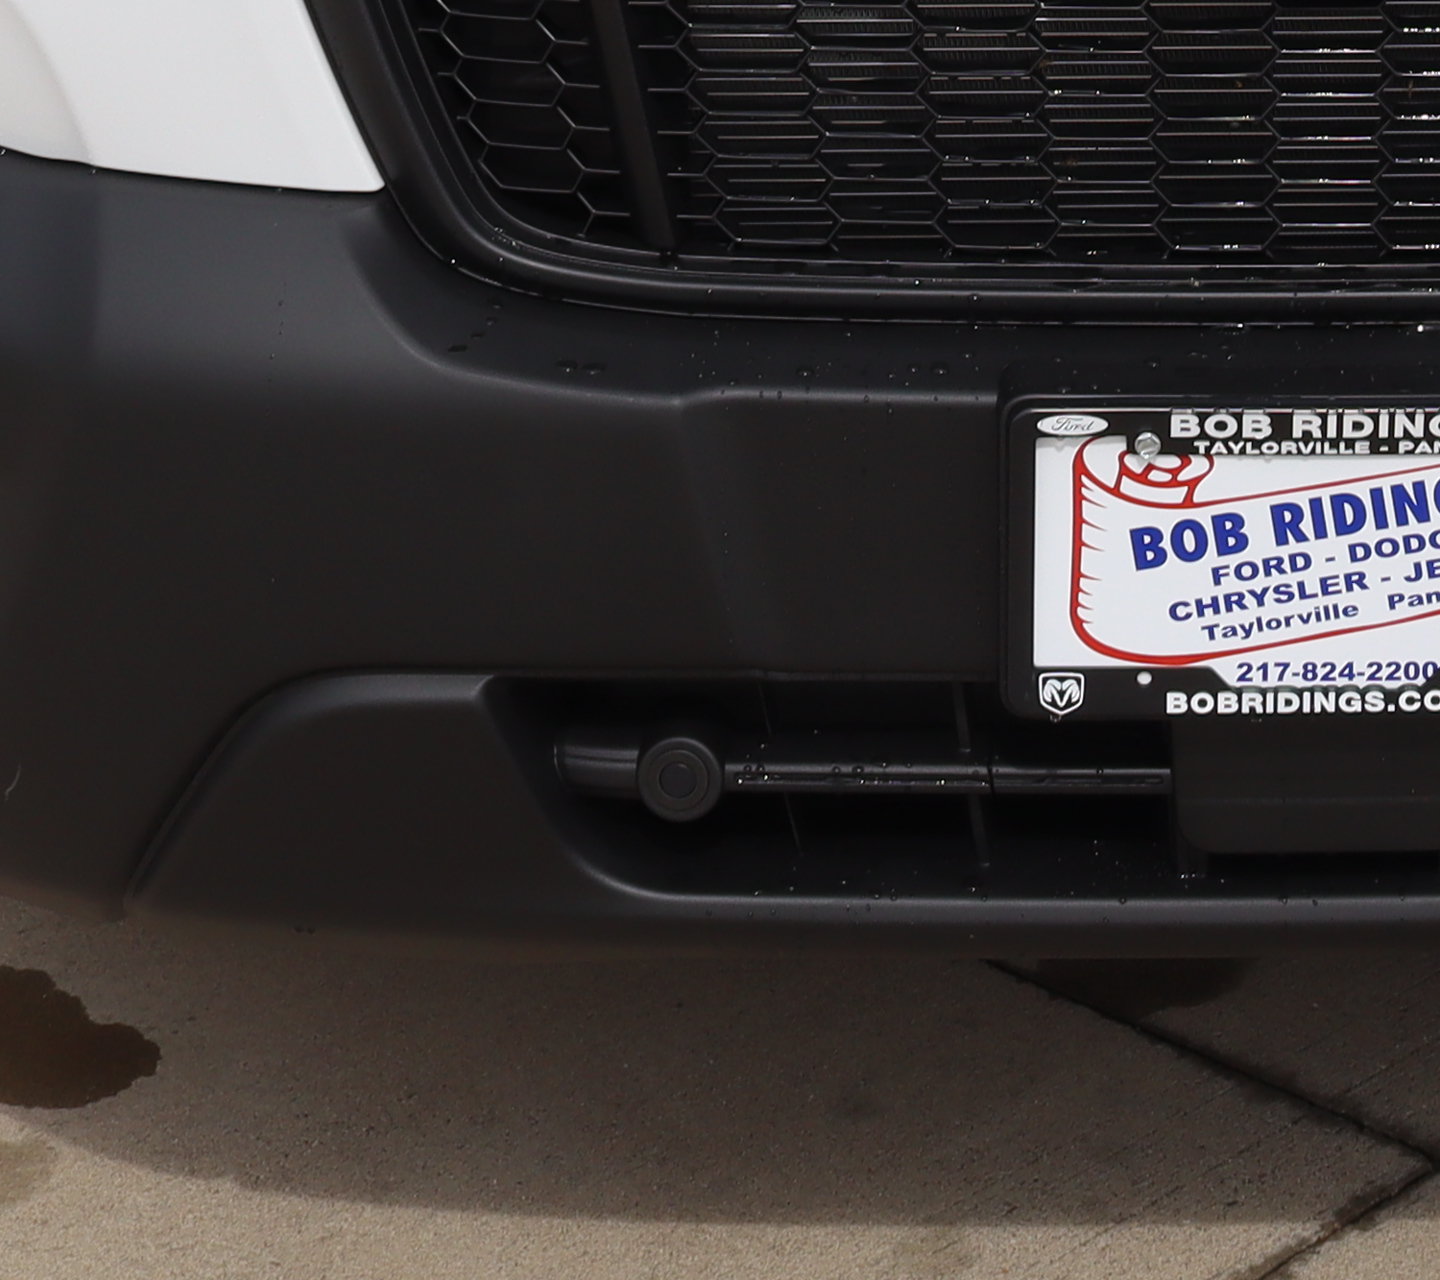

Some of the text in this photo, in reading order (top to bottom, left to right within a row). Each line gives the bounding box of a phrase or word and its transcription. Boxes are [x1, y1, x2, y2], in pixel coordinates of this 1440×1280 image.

[1051, 415, 1095, 432] Ford
[1170, 411, 1273, 440] BOB
[1192, 440, 1370, 456] TAYLORVILLE
[1128, 511, 1250, 572] BOB
[1210, 551, 1313, 587] FORD
[1168, 571, 1370, 623] CHRYSLER
[1200, 602, 1360, 642] Taylorville
[1235, 660, 1439, 684] 217-824-2200
